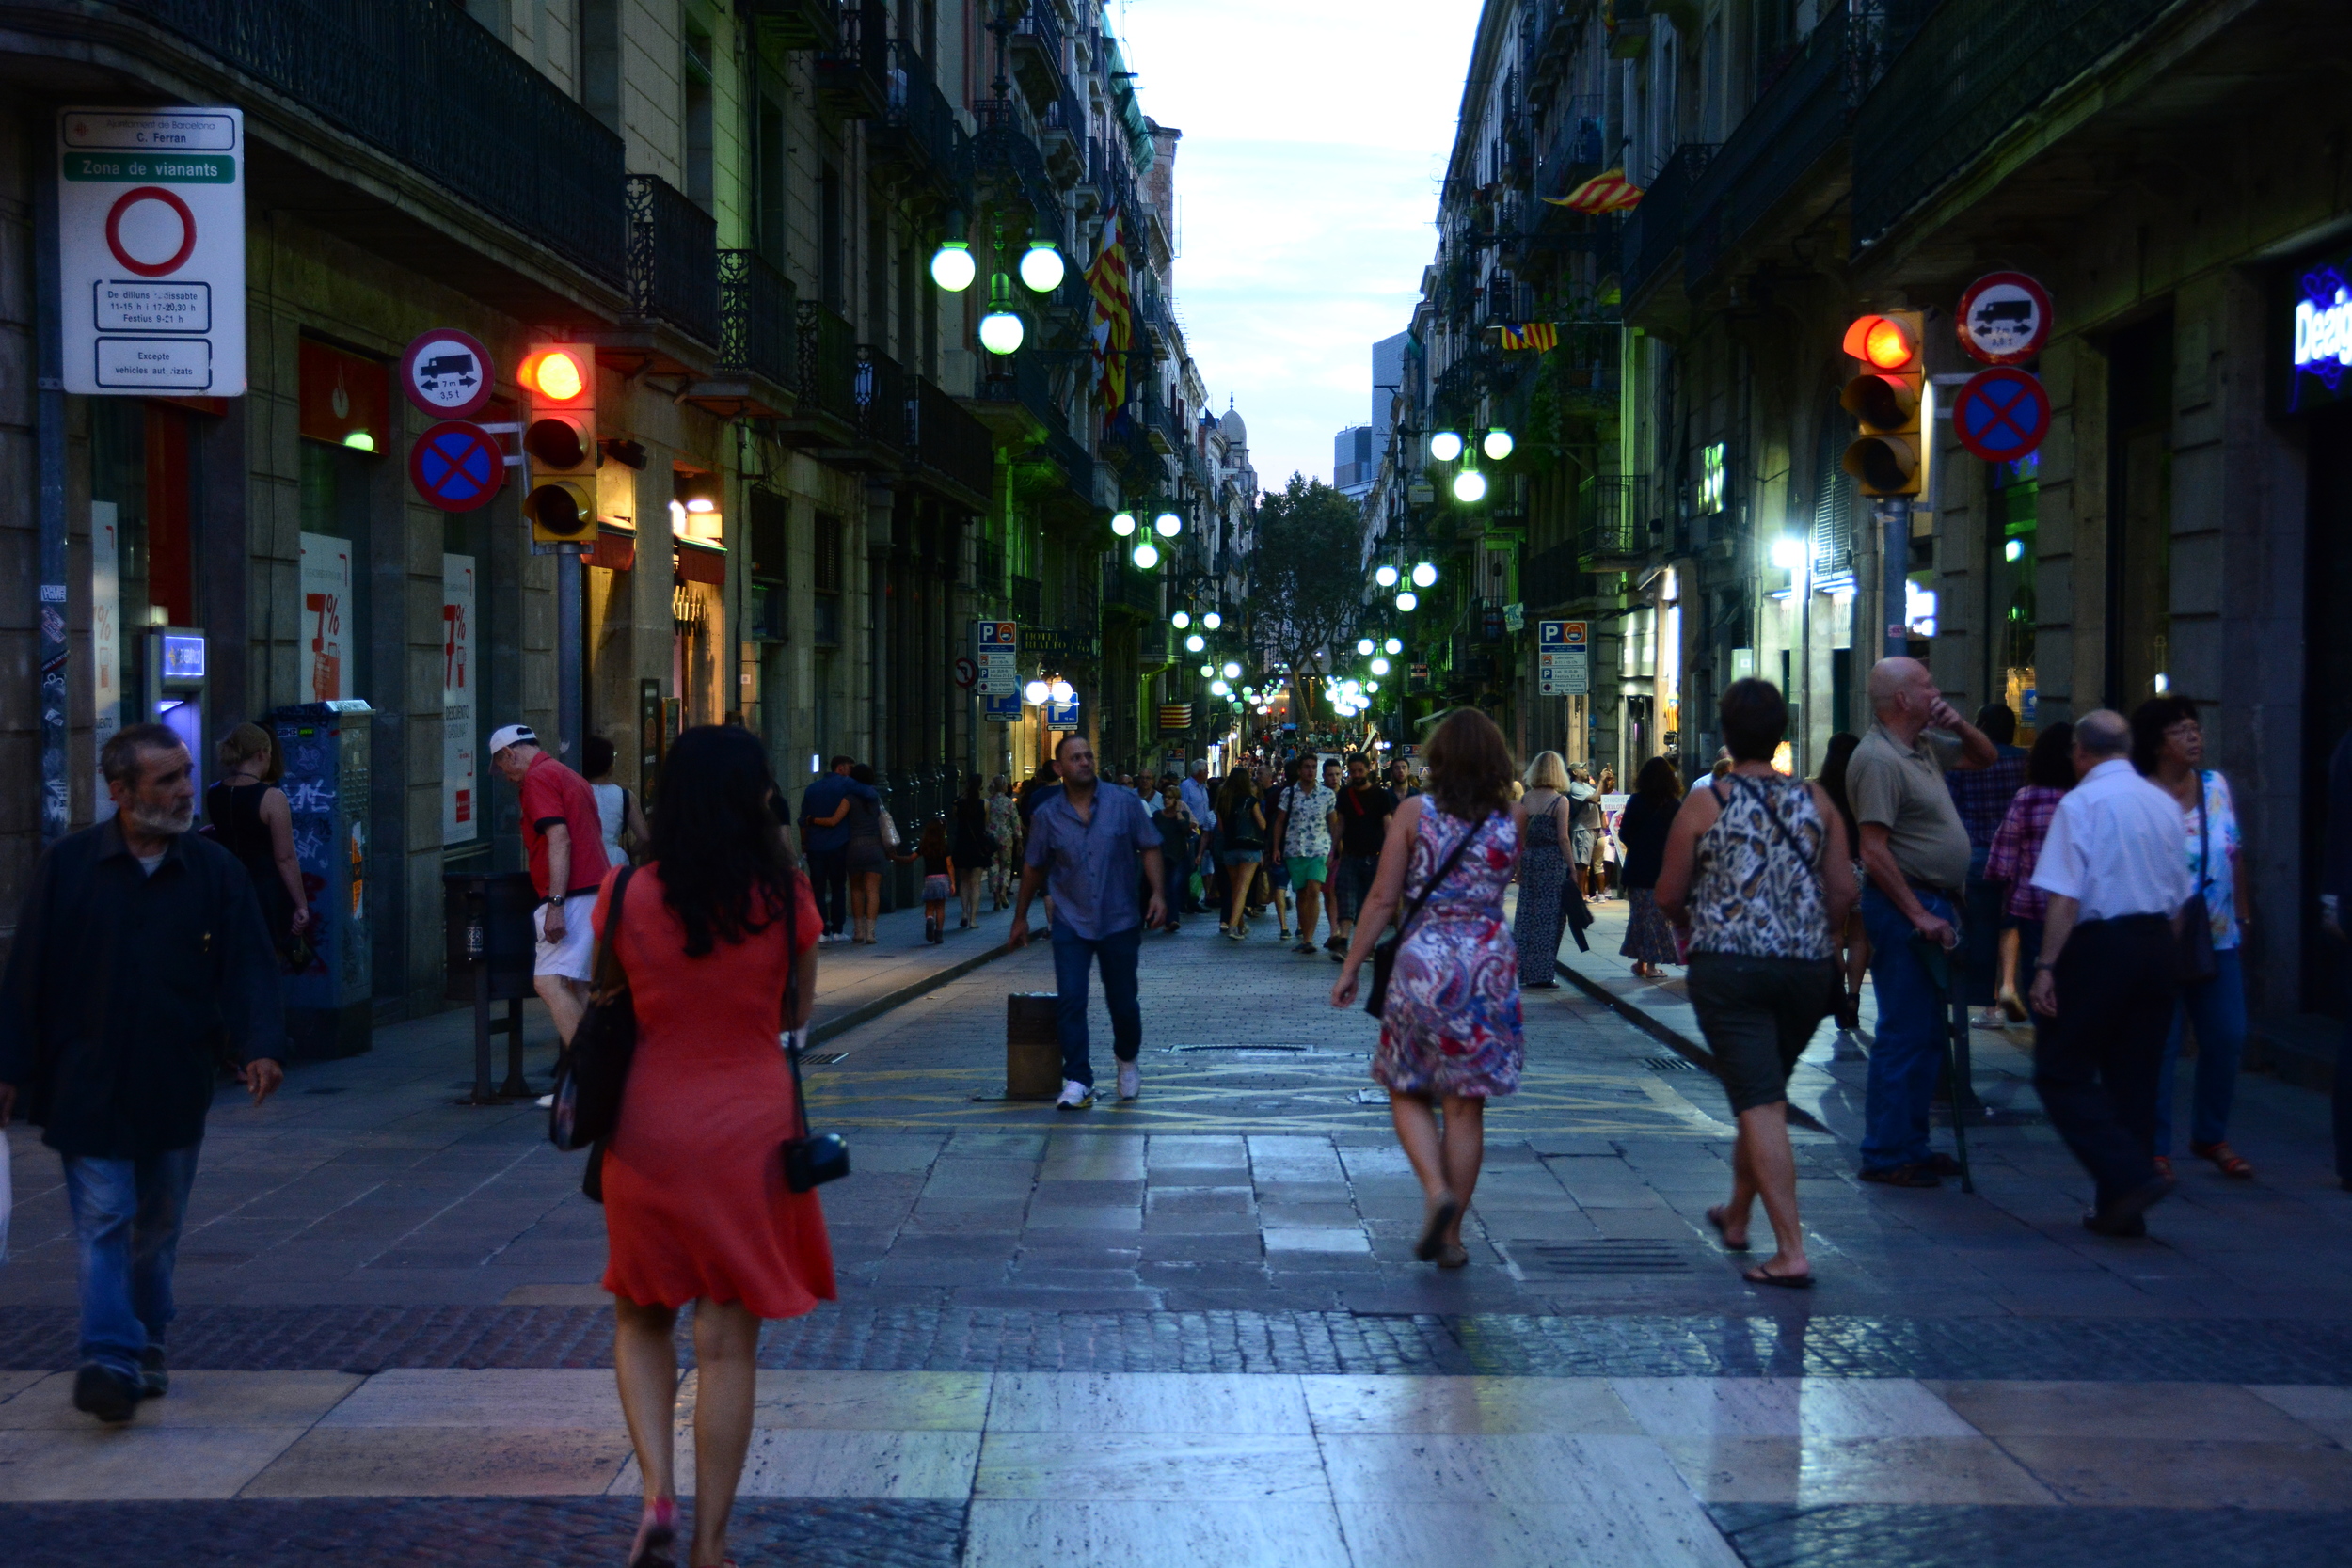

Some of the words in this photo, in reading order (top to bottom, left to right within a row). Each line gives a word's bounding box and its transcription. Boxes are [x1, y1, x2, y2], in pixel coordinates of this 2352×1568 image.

[105, 119, 155, 130] Ajuntament
[157, 120, 169, 130] de
[171, 120, 215, 131] Barcelona
[136, 132, 148, 142] C.
[153, 133, 187, 143] Ferran
[82, 159, 120, 175] Zona
[128, 161, 147, 176] de
[155, 162, 218, 177] vianants
[107, 290, 119, 299] De
[122, 291, 151, 300] dilluns
[110, 302, 133, 311] 11-15
[136, 303, 142, 311] h
[153, 303, 187, 312] 17-20,30
[190, 304, 196, 312] h
[123, 313, 152, 323] Festius
[178, 315, 183, 324] h
[137, 352, 170, 361] Excepte
[115, 366, 149, 374] vehicles
[152, 367, 193, 375] autizats
[440, 390, 453, 401] 3,5
[455, 389, 460, 398] t
[983, 625, 993, 641] P
[1025, 632, 1060, 641] HOTEL
[1545, 625, 1559, 641] P
